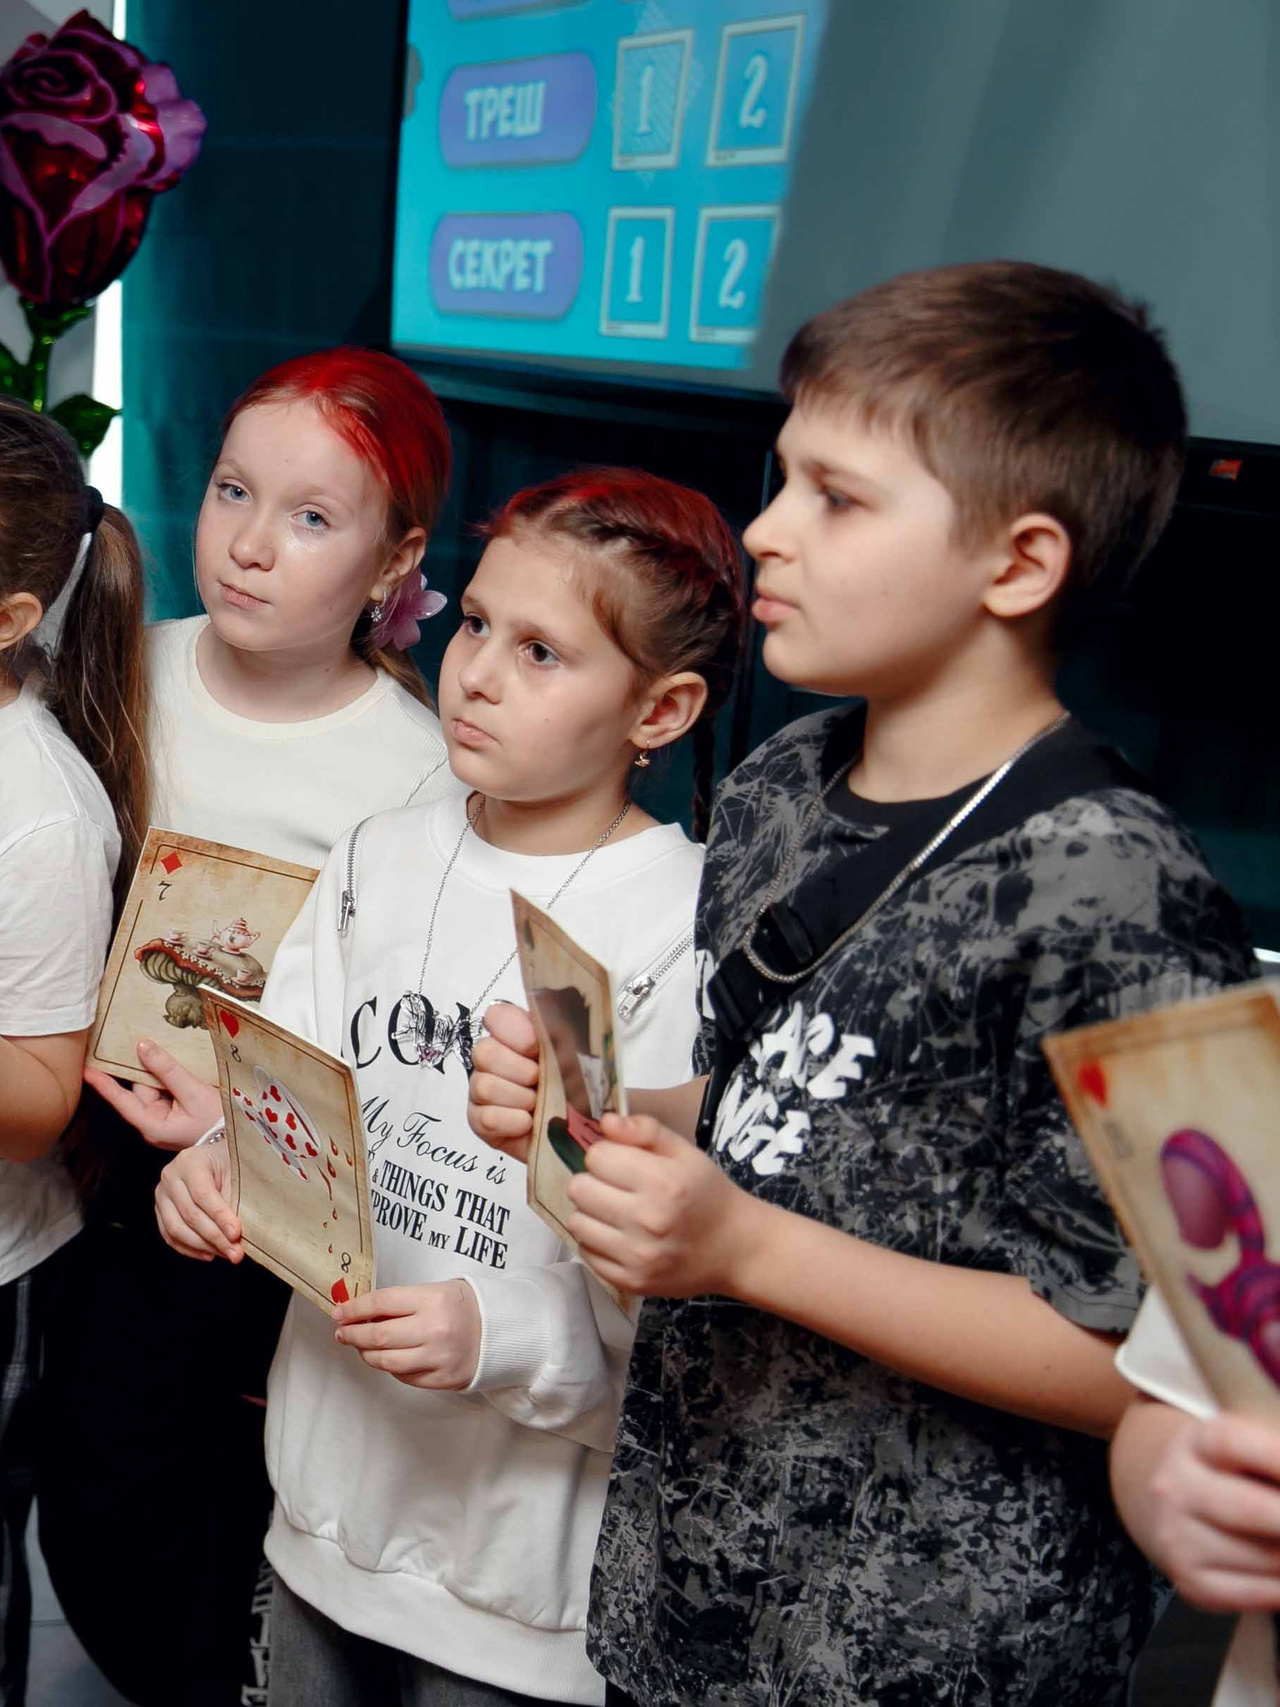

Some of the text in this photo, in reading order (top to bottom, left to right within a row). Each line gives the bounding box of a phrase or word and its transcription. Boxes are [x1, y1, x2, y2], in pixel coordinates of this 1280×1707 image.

[464, 53, 768, 141] ТРЕШ 1 2
[448, 235, 748, 309] СЕКРЕТ 1 2
[157, 881, 172, 901] 7
[231, 1044, 241, 1064] 8
[361, 1096, 506, 1185] My Focus is
[379, 1160, 449, 1212] THINGS
[454, 1189, 510, 1236] THAT
[341, 1252, 351, 1273] 8
[428, 1230, 450, 1250] MY
[453, 1226, 508, 1270] LIFE
